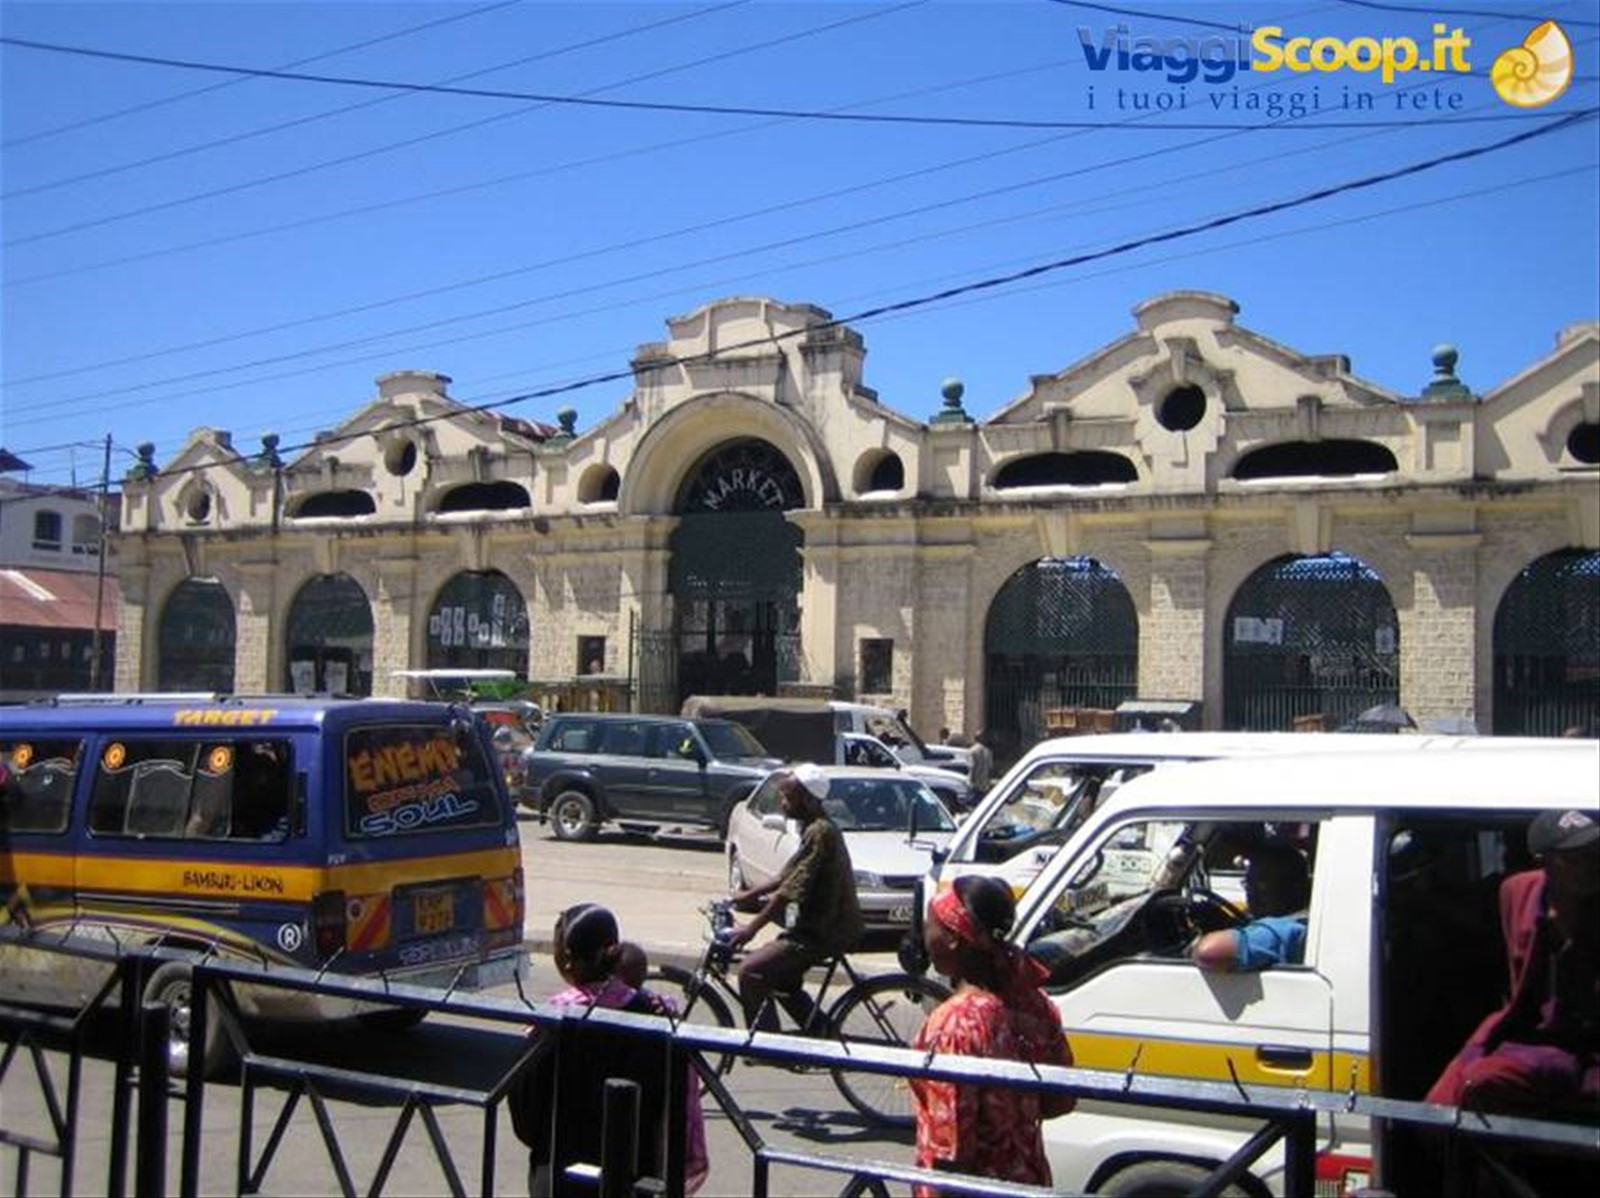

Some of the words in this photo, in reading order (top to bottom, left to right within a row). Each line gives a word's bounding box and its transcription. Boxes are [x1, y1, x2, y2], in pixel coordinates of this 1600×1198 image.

[704, 468, 784, 510] MARKET
[173, 709, 278, 726] TARGET
[360, 793, 479, 837] SOUL
